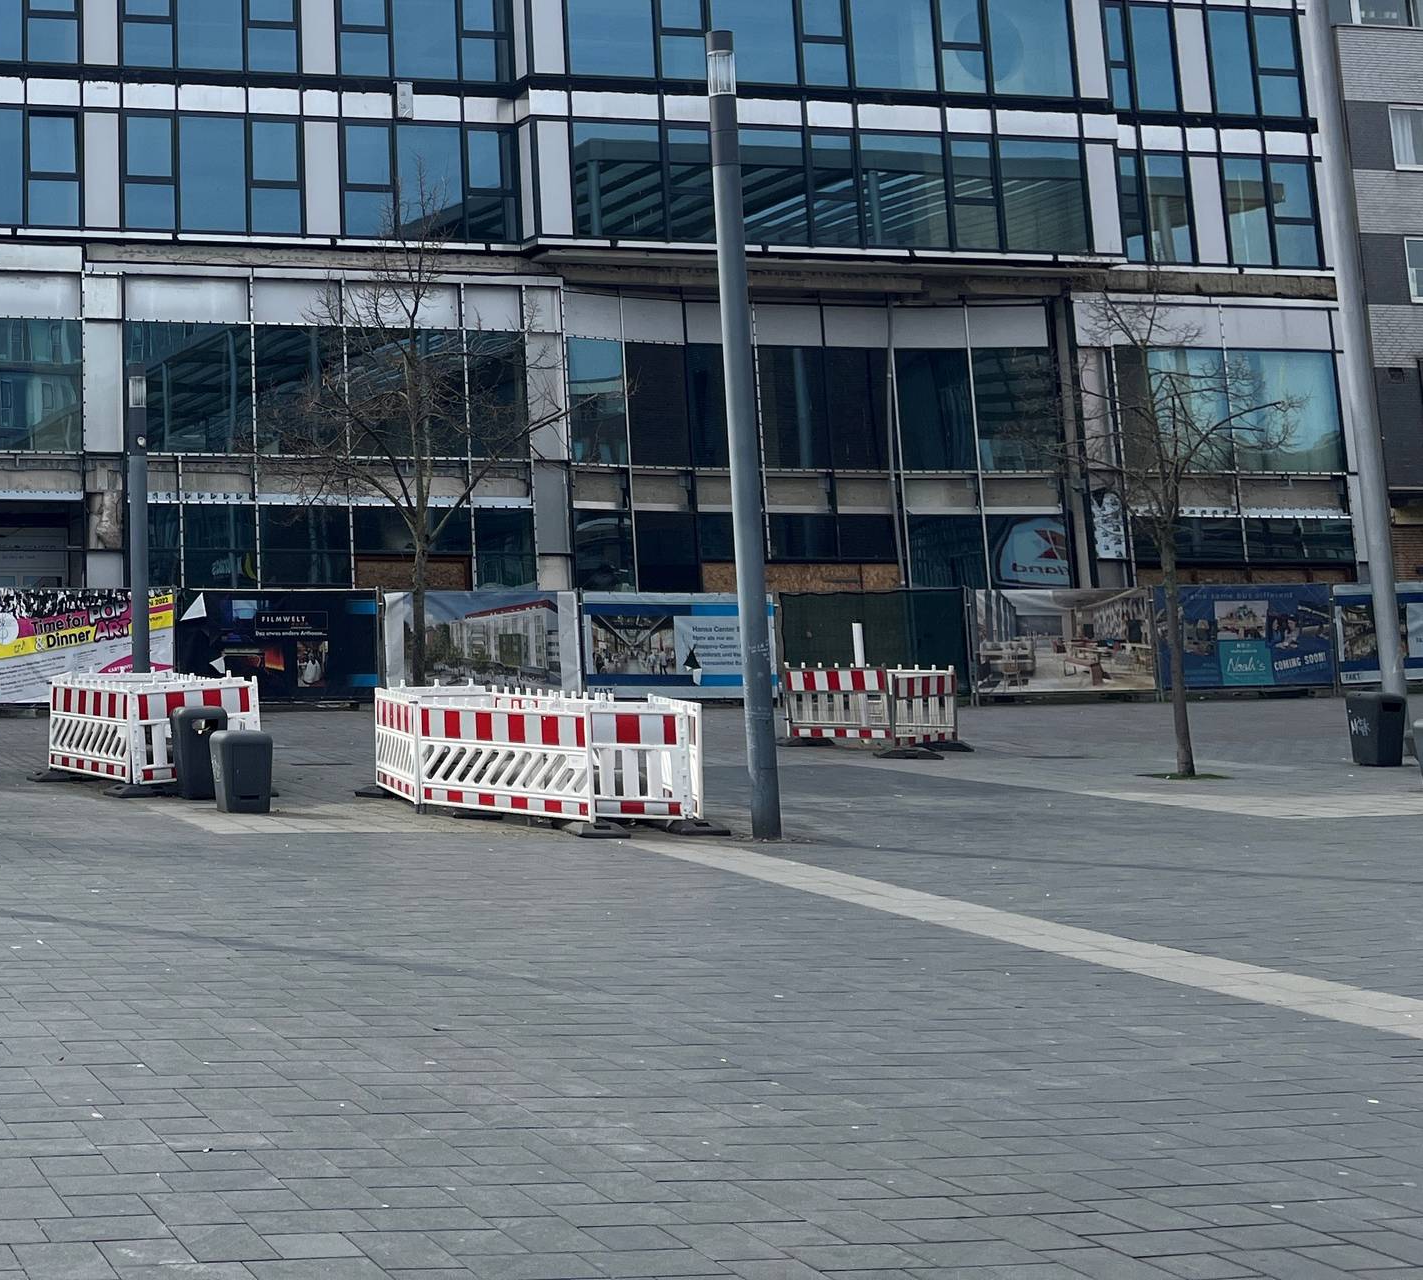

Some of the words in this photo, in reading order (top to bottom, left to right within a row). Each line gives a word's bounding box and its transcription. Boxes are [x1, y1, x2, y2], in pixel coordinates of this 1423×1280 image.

[31, 617, 64, 634] Time
[66, 613, 86, 629] for
[88, 600, 129, 626] POP
[35, 638, 45, 652] &
[46, 630, 91, 648] Dinner
[94, 619, 131, 642] ART
[1227, 656, 1266, 672] Noah's
[1274, 656, 1301, 671] COMING
